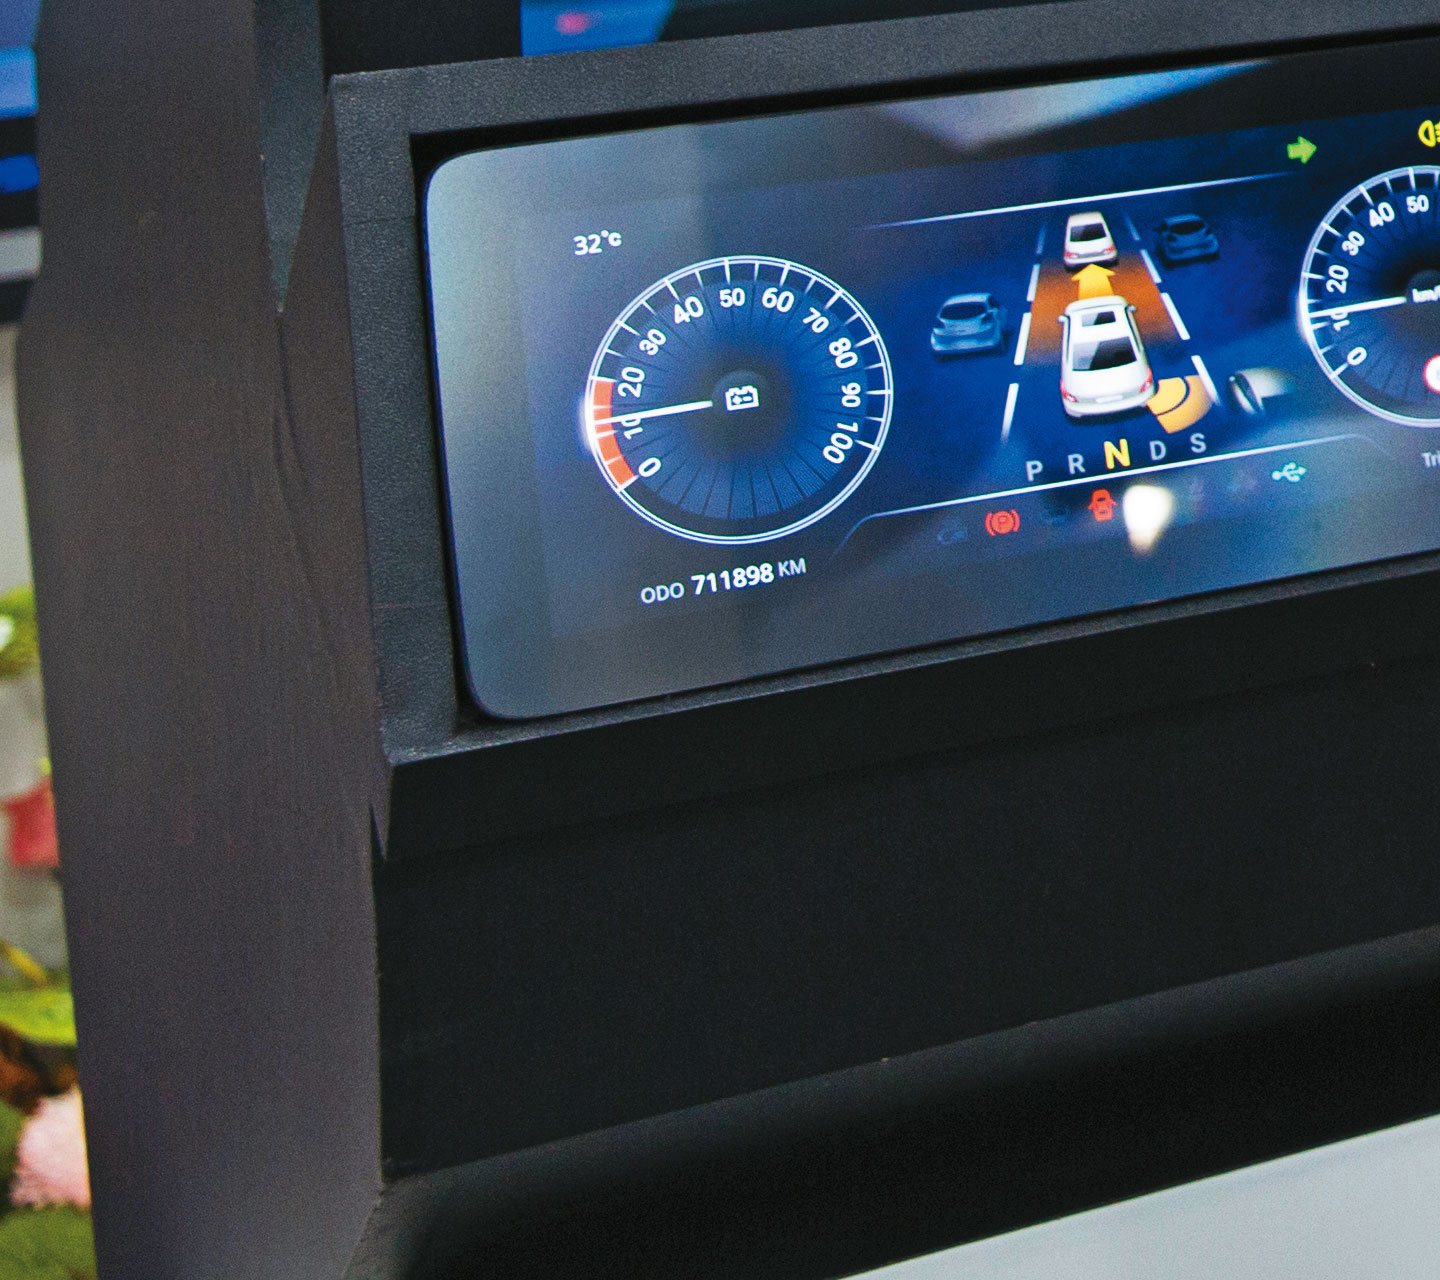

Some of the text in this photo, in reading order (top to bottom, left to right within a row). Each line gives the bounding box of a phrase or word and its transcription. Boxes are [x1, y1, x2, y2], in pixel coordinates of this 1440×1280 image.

[1325, 264, 1350, 294] 20
[1341, 230, 1366, 257] 30
[1368, 201, 1396, 228] 40
[1405, 194, 1431, 214] 50
[673, 295, 705, 324] 40
[719, 287, 746, 307] 50
[761, 289, 795, 314] 60
[802, 307, 830, 334] 70
[638, 328, 668, 356] 30
[827, 336, 858, 370] 80
[617, 366, 646, 398] 20
[840, 381, 862, 408] 90
[822, 421, 860, 464] 100
[1025, 432, 1207, 482] P R N D S
[638, 456, 662, 478] 0
[640, 557, 808, 605] ODO 711898 KM
